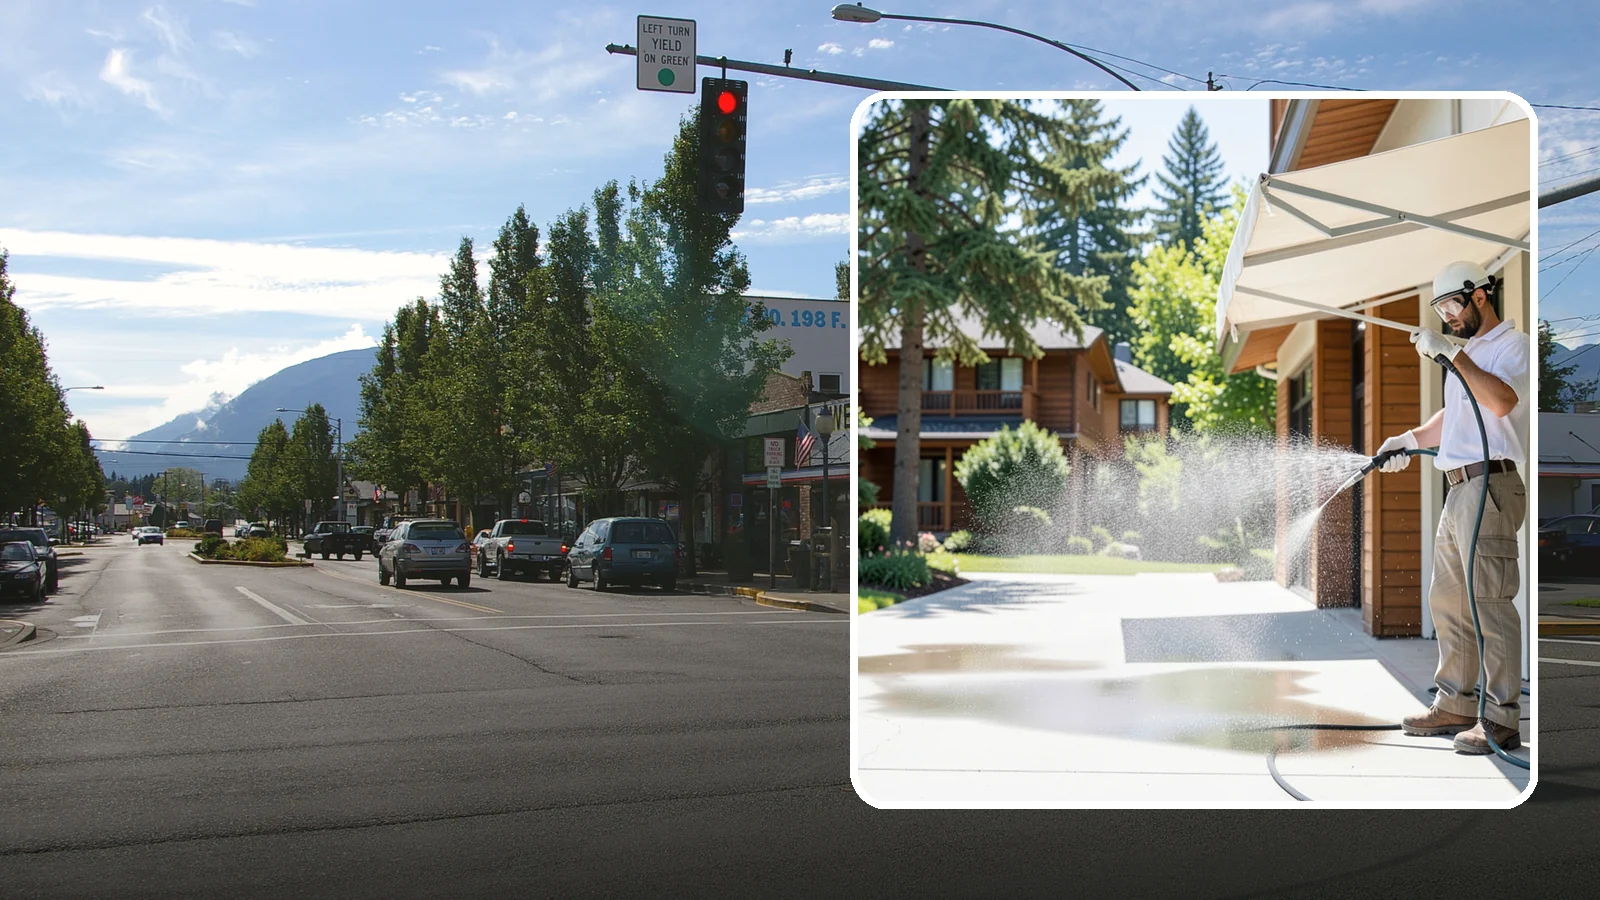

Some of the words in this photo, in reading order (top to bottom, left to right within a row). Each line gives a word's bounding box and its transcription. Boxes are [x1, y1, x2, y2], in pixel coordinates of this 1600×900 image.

[643, 23, 663, 34] LEFT
[668, 25, 690, 36] TURN
[652, 37, 682, 51] YIELD
[644, 53, 656, 63] ON
[661, 55, 688, 66] GREEN
[761, 308, 785, 327] O.
[791, 309, 826, 328] 198
[831, 311, 846, 329] F.
